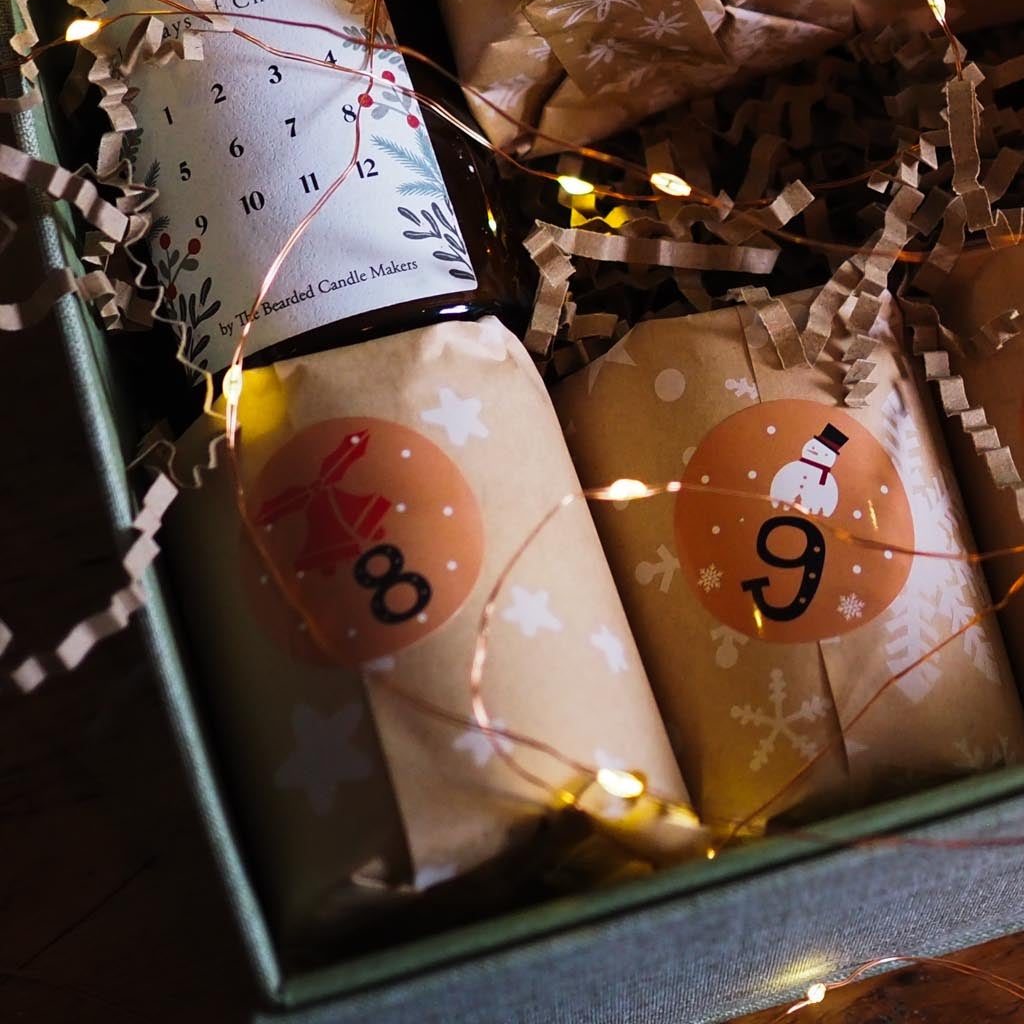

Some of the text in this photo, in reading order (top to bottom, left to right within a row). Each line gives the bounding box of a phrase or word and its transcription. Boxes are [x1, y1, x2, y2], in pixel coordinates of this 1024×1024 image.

[162, 17, 192, 40] ays
[162, 49, 338, 126] 1 2 3 4
[178, 103, 357, 182] 5 6 7 8
[194, 158, 379, 236] 9 10 11 12
[219, 258, 419, 337] by The Bearded Candle Makers
[353, 543, 433, 625] 8
[740, 515, 827, 622] 9
